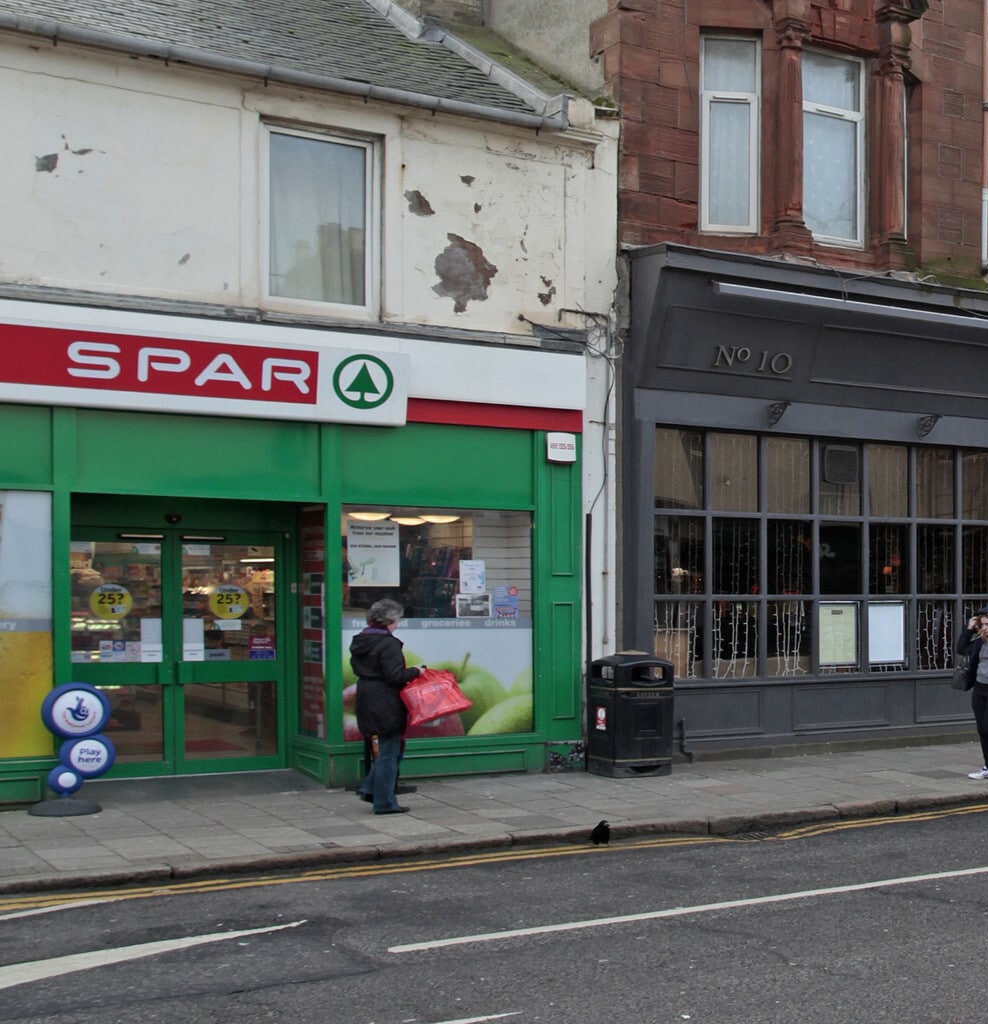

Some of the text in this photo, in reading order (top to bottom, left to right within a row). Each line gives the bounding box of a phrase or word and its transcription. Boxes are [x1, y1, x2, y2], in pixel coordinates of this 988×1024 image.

[67, 341, 310, 394] SPAR
[757, 351, 792, 374] 10
[98, 593, 124, 604] 25?
[216, 593, 241, 605] 25?
[421, 620, 471, 629] groceries
[485, 619, 516, 628] drinks
[79, 748, 101, 756] Play
